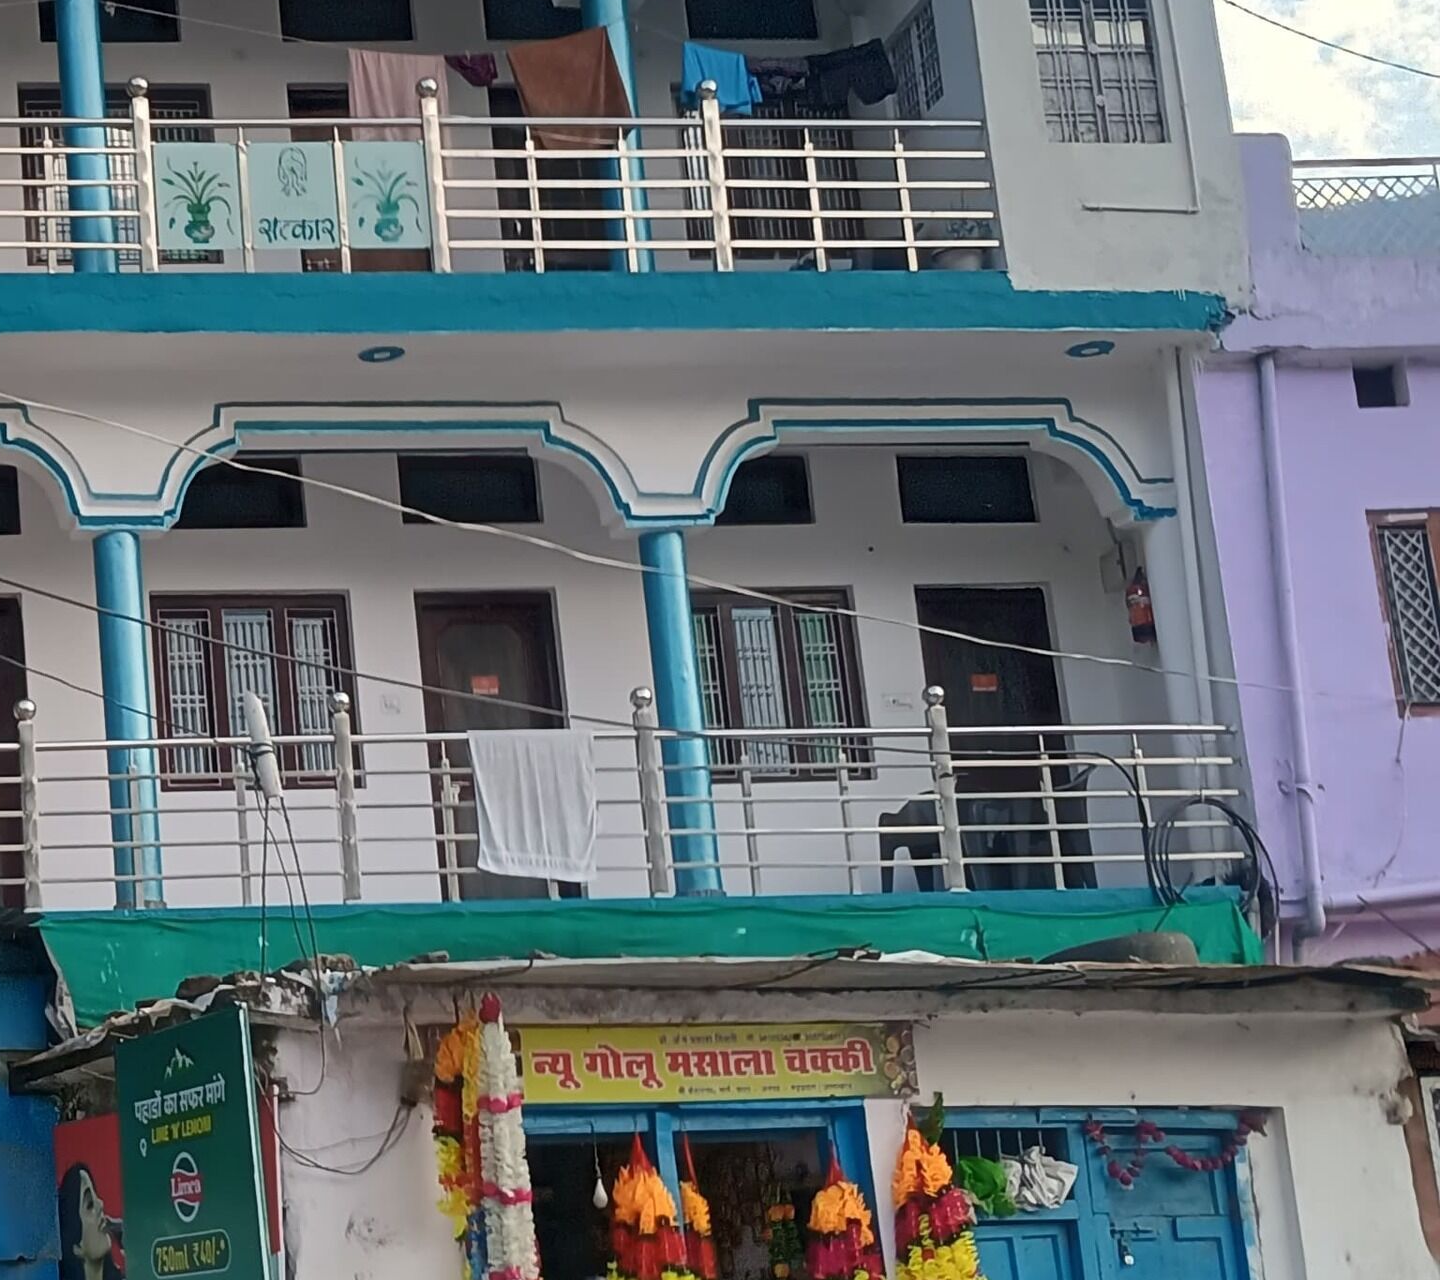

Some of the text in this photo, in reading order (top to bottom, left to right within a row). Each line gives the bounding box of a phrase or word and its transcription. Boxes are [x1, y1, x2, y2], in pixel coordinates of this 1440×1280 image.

[258, 217, 335, 243] सत्कार
[531, 1039, 874, 1089] न्यू गोलू मसाला चक्की
[163, 1093, 178, 1115] का
[156, 1244, 190, 1273] 750ml
